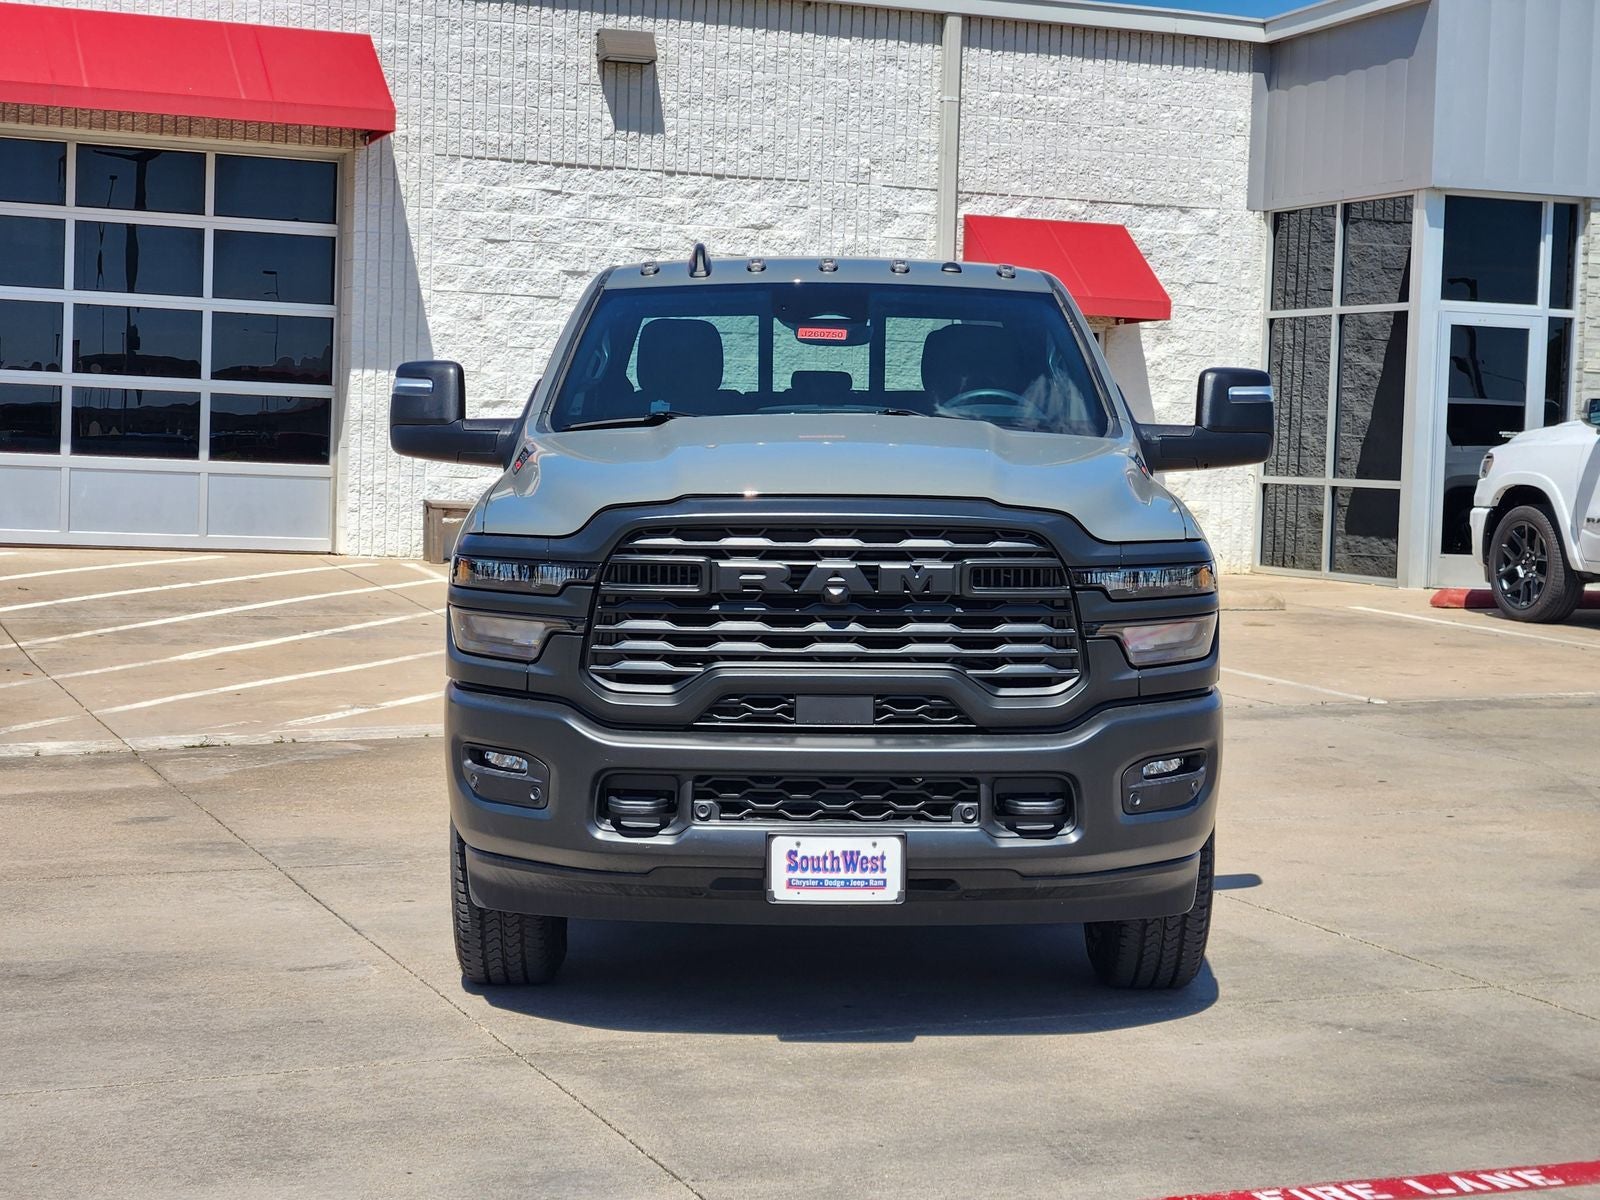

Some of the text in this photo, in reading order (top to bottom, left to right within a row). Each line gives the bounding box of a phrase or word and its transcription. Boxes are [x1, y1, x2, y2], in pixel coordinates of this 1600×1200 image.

[801, 330, 844, 339] J260750
[717, 560, 955, 595] RAM
[786, 849, 887, 874] SouthWest
[791, 878, 884, 888] Chrysler Dodge Jeep Ram
[1250, 1169, 1566, 1200] FIRE LANE
